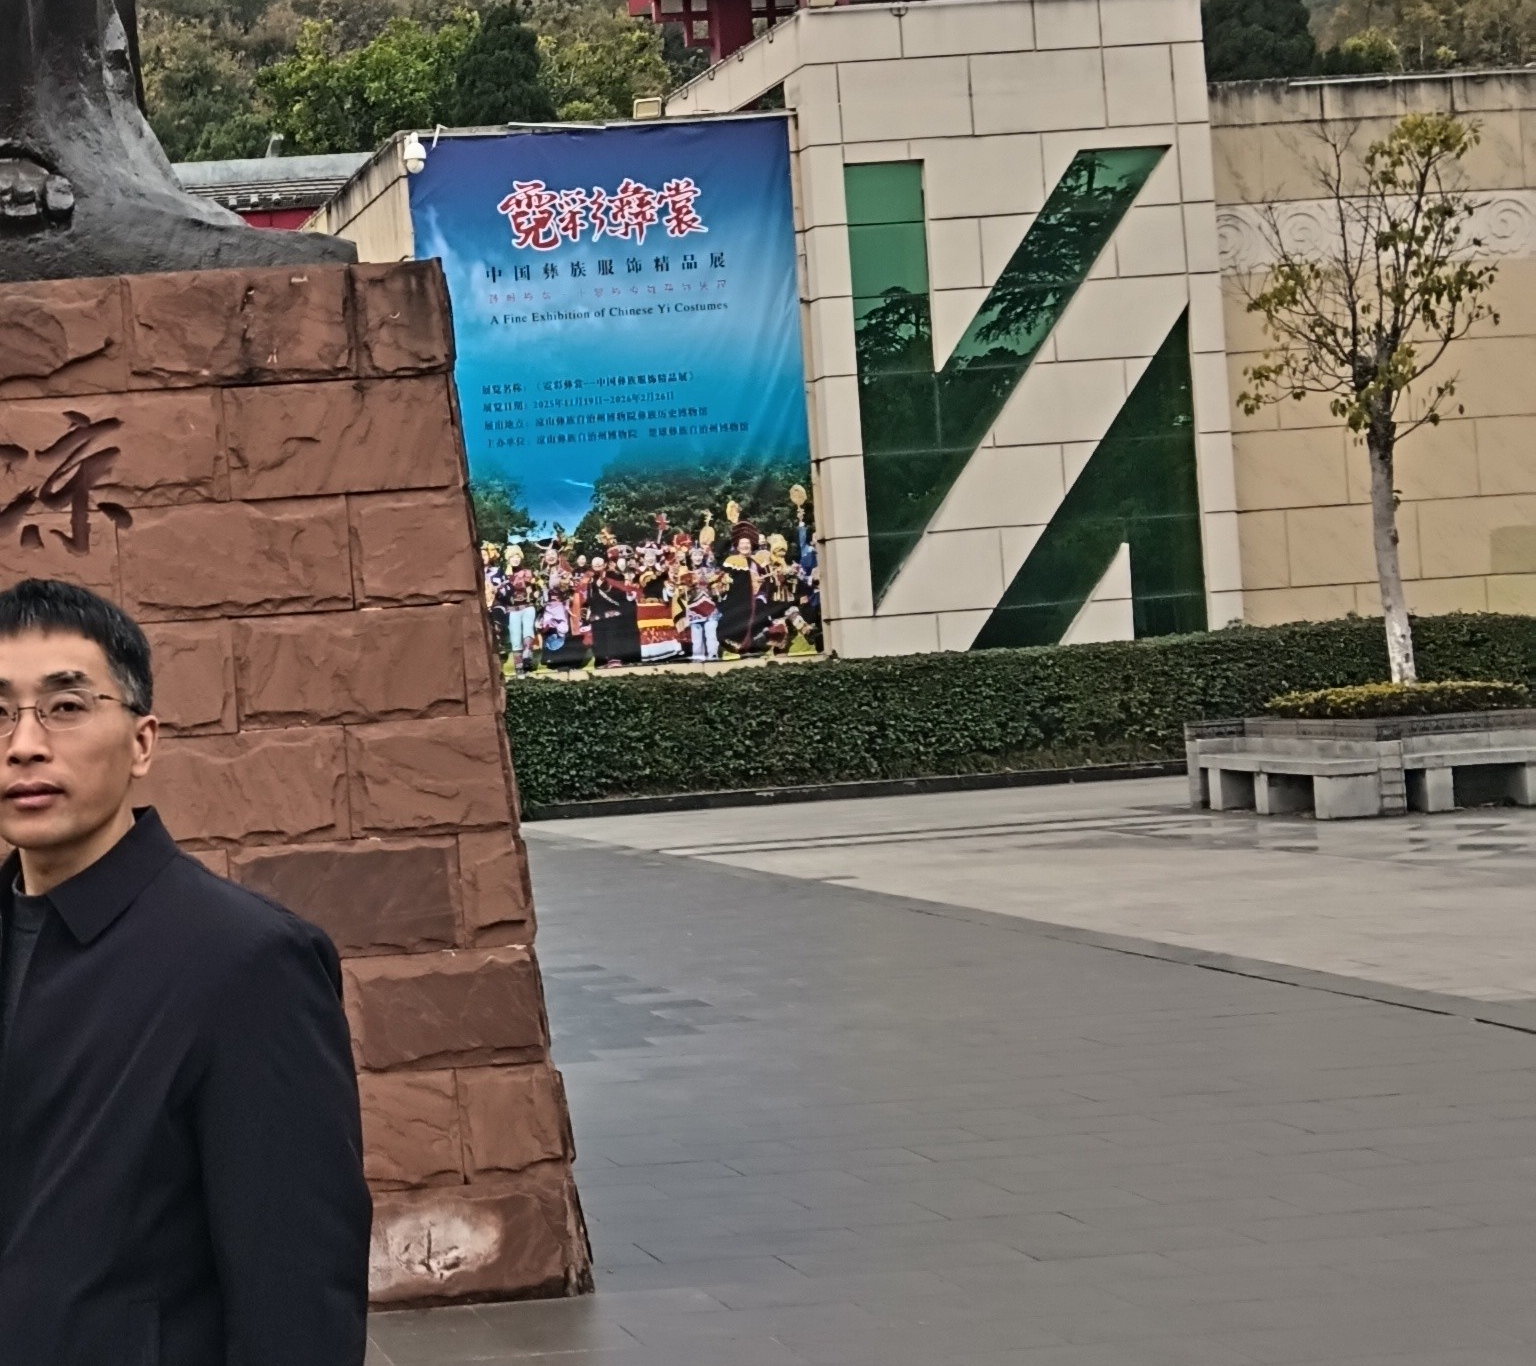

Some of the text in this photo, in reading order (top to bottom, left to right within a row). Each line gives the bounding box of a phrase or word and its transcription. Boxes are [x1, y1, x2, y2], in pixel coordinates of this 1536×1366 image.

[497, 177, 708, 251] 霓彩彝裳
[486, 252, 725, 283] 中国彝族服饰精品展
[490, 302, 728, 325] A Fine Exhibition of Chinese Yi Costumes
